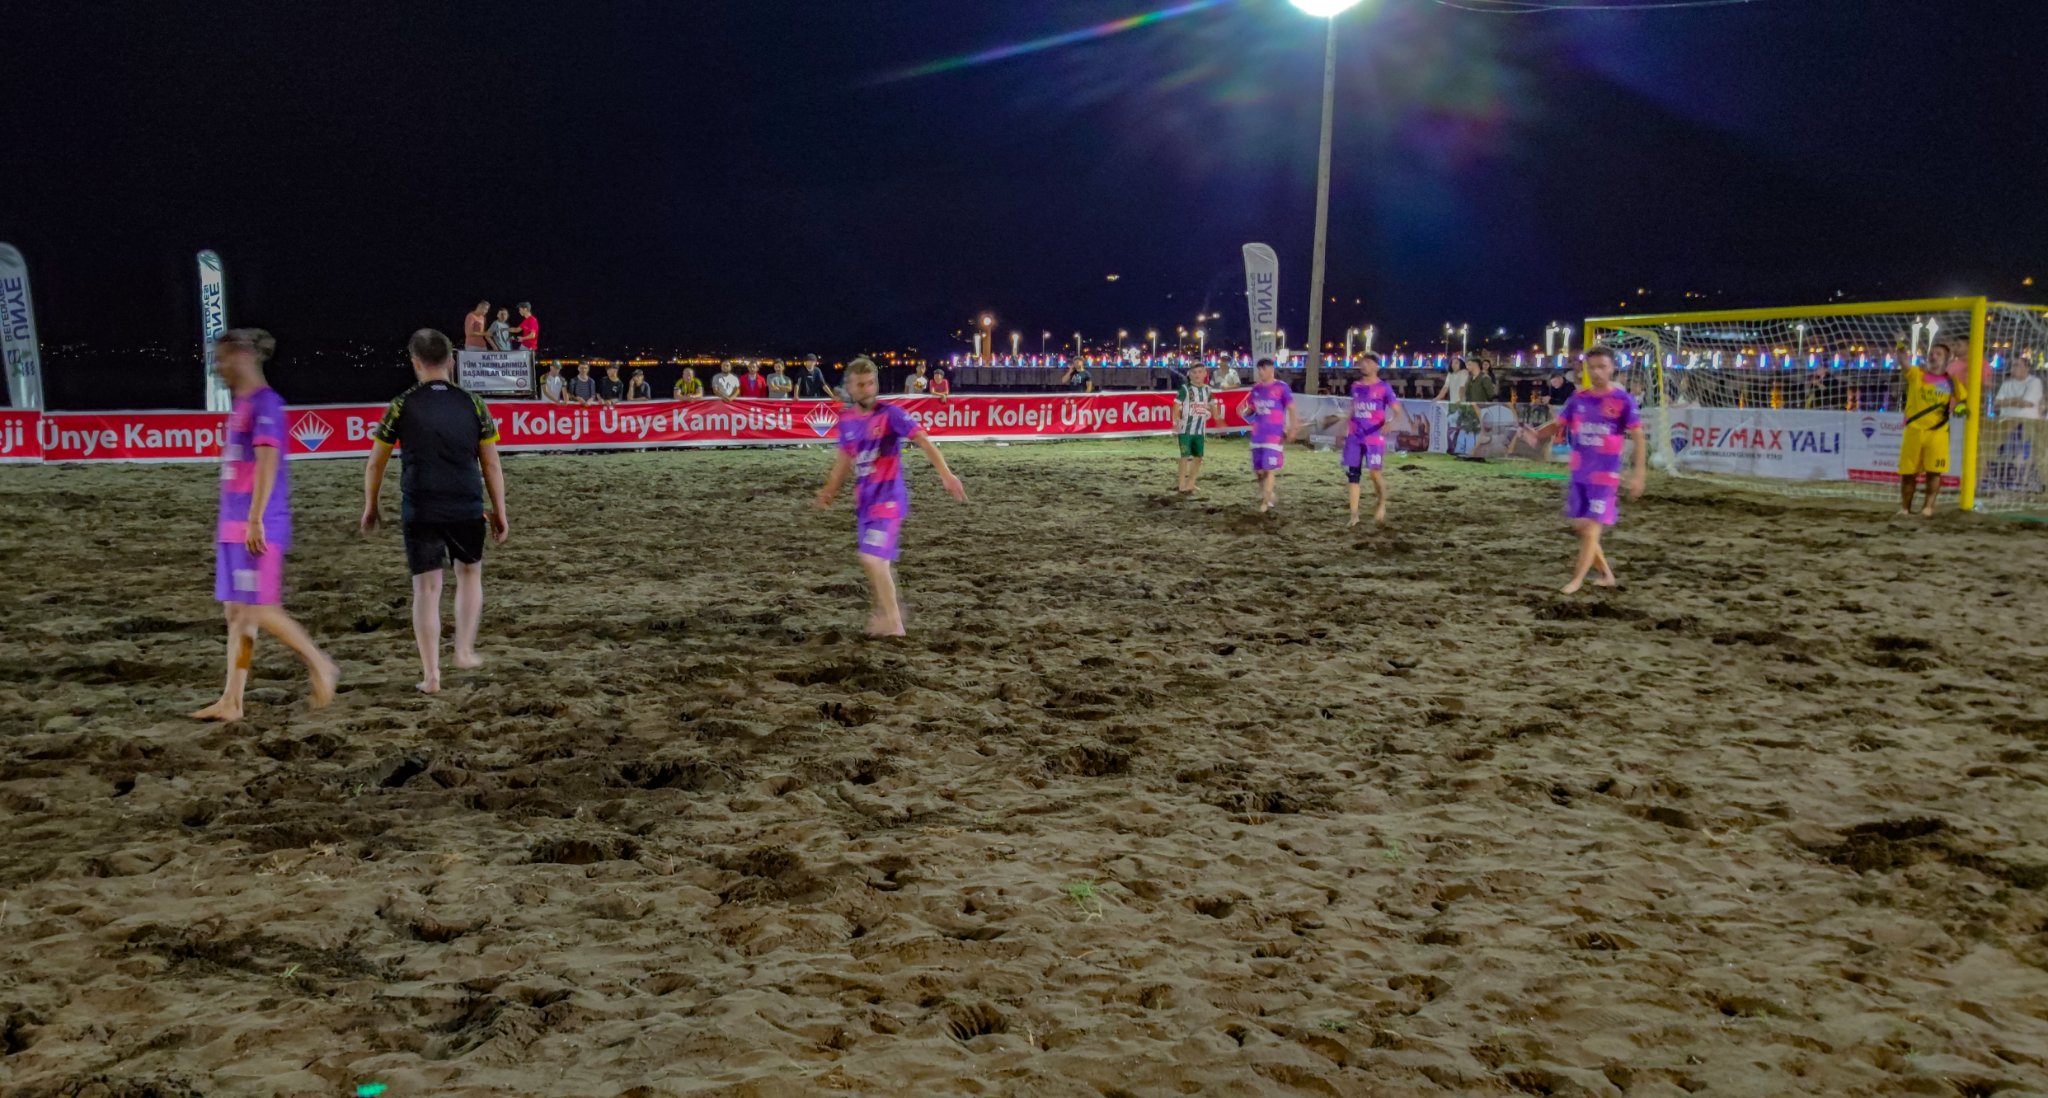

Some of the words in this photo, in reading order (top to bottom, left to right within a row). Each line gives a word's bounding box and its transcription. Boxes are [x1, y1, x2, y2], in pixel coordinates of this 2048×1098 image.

[463, 360, 477, 368] TÜM
[463, 370, 500, 378] BAŞARILAR
[502, 369, 529, 377] DİLERİM
[512, 410, 589, 440] Koleji
[600, 405, 667, 438] Ünye
[673, 407, 792, 436] Kampüsü
[988, 398, 1053, 432] Koleji
[1060, 400, 1118, 431] Ünye
[37, 419, 118, 456] Ünye
[124, 422, 227, 454] Kampü
[1691, 427, 1783, 450] RE/MAX
[1789, 430, 1840, 454] YALI
